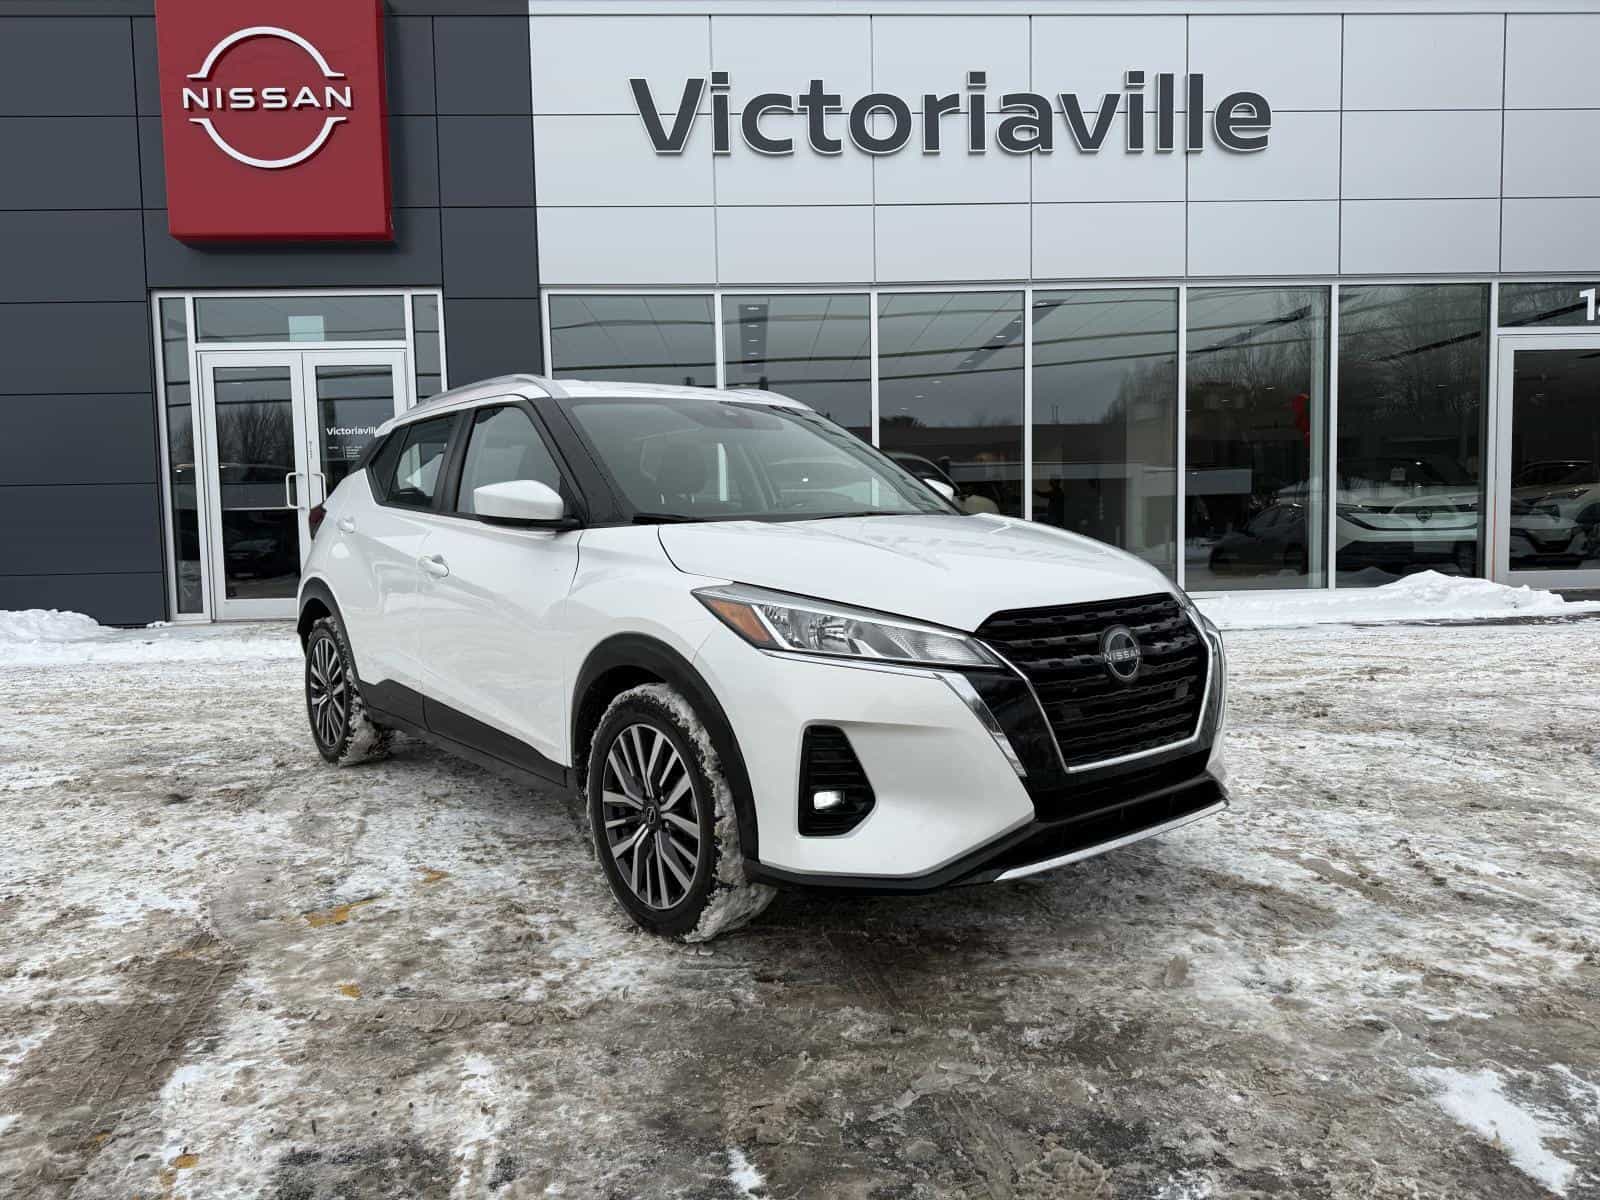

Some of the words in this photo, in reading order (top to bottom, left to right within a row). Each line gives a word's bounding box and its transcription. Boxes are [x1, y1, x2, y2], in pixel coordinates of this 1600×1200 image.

[182, 86, 352, 109] NISSAN
[628, 71, 1273, 157] Victoriaville
[1579, 288, 1600, 321] 1
[326, 425, 377, 436] Victoriavill
[1103, 647, 1141, 664] NISSAN
